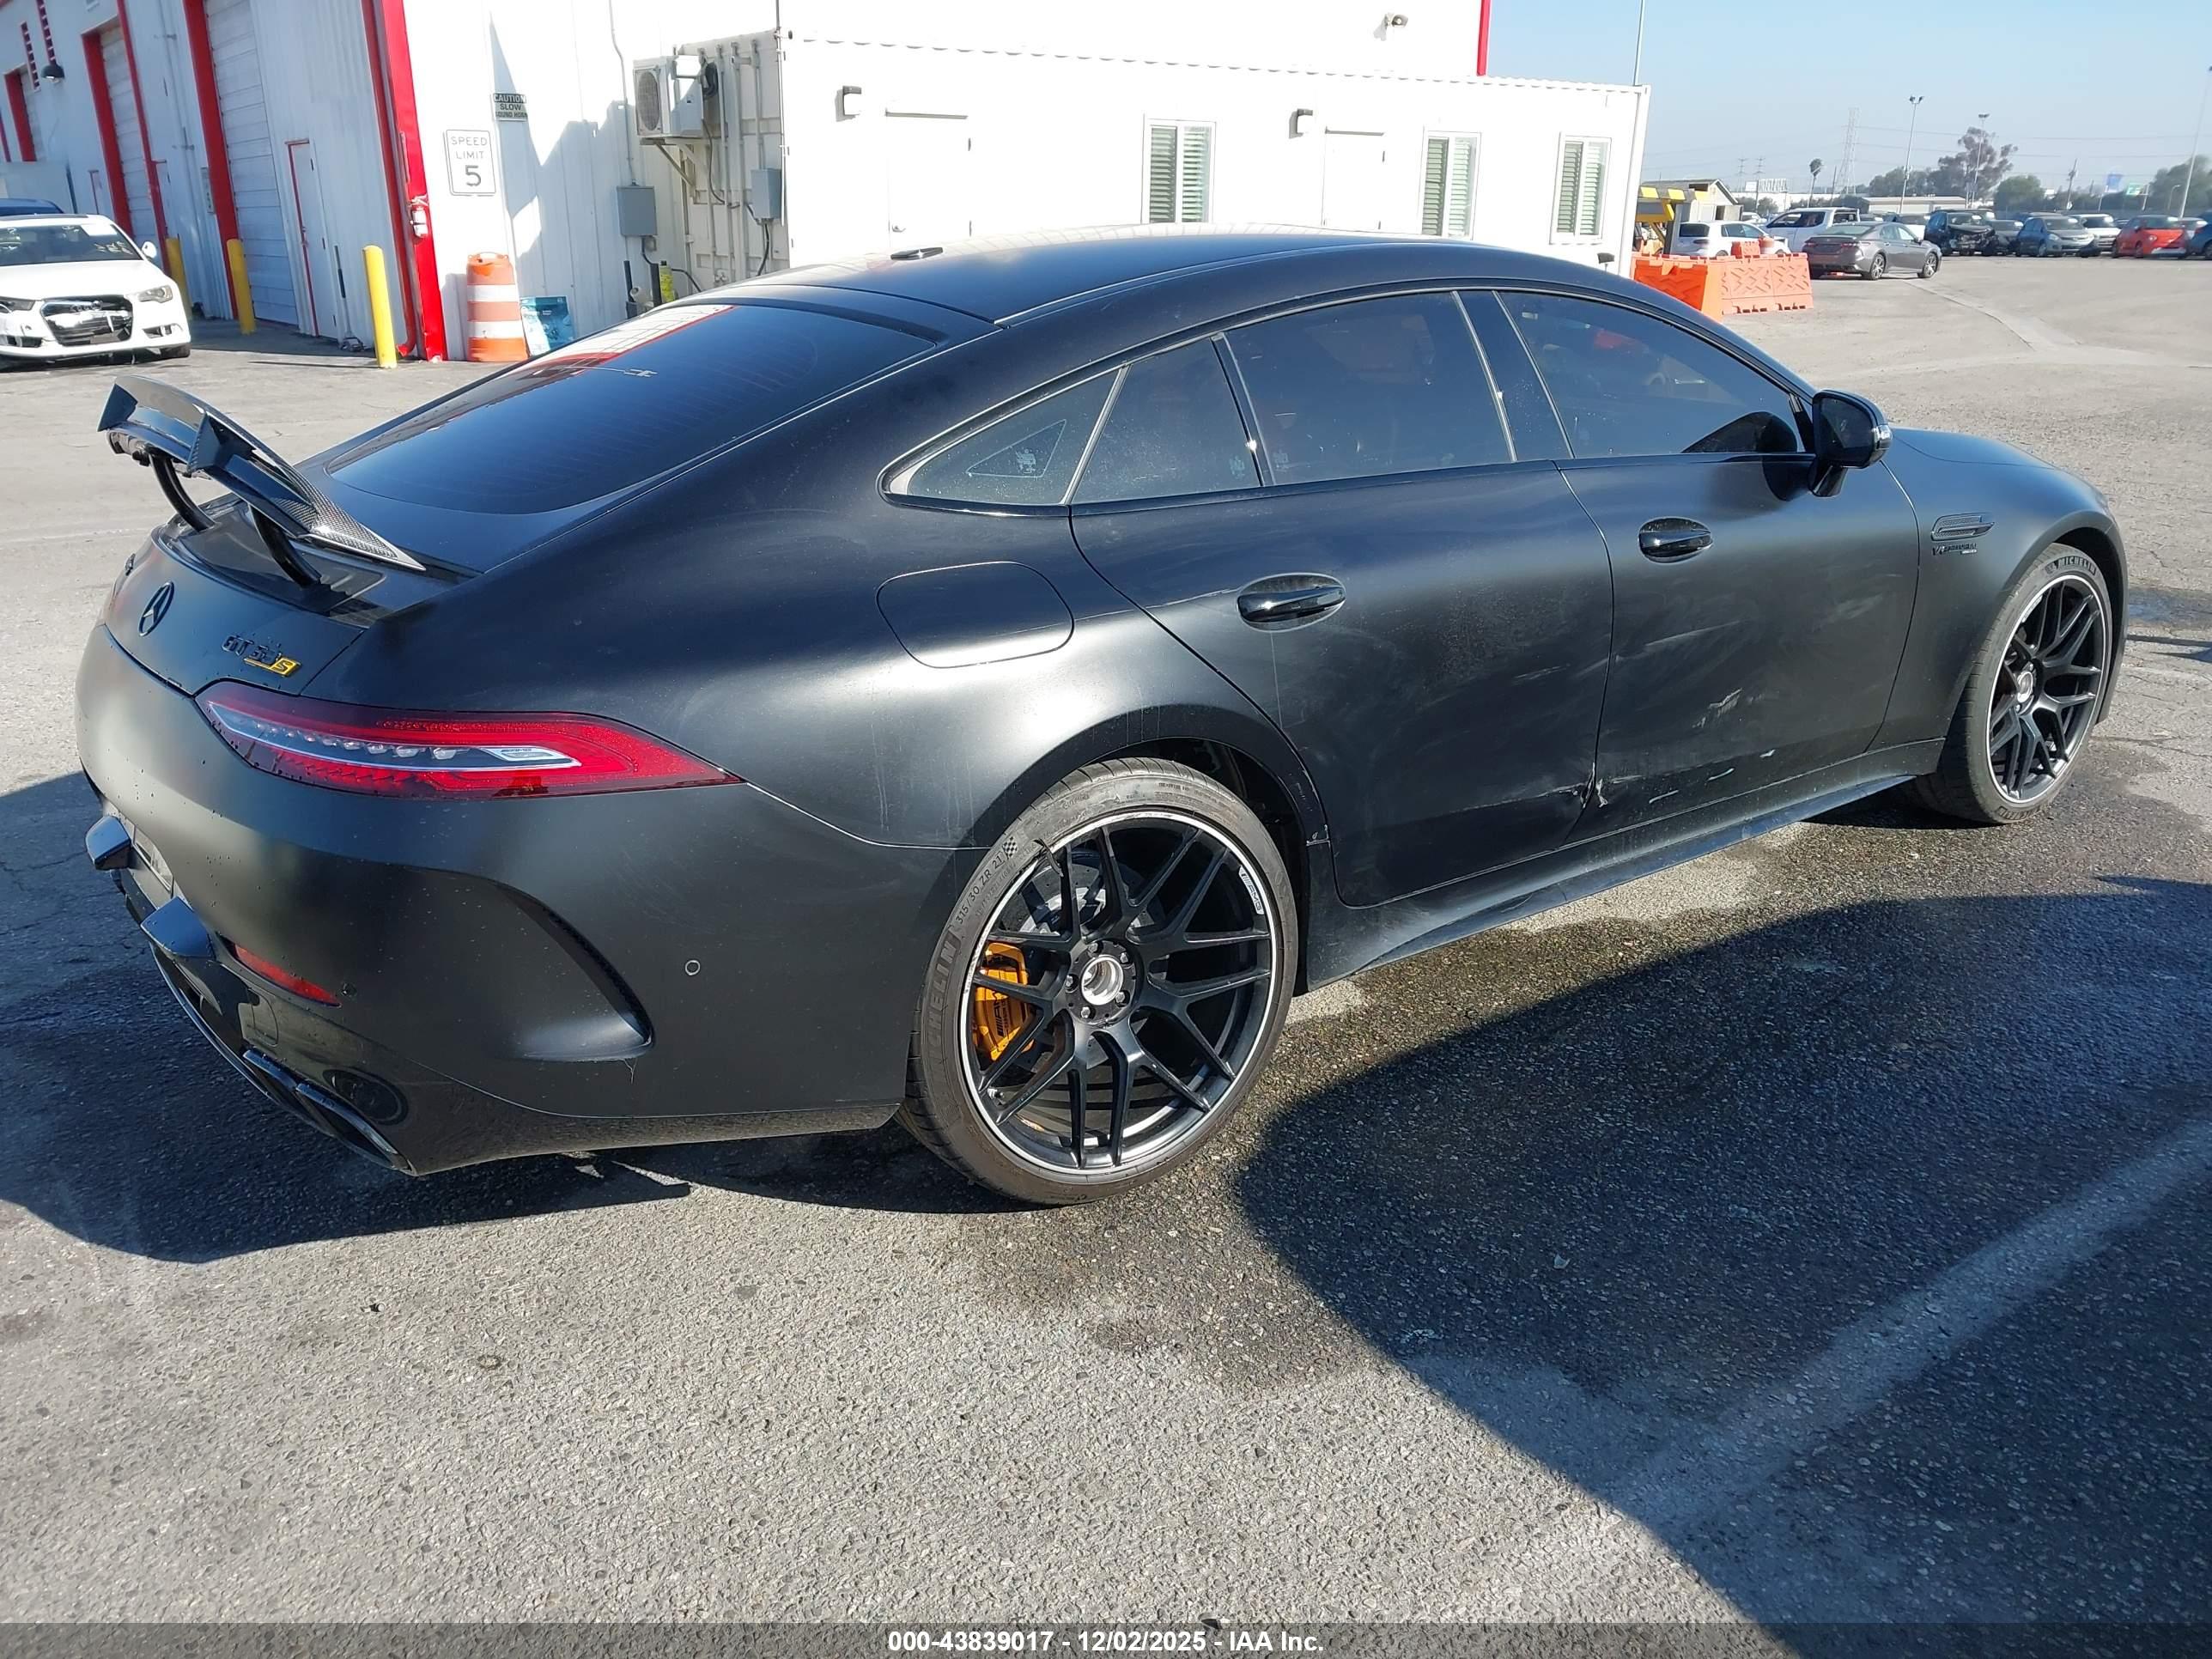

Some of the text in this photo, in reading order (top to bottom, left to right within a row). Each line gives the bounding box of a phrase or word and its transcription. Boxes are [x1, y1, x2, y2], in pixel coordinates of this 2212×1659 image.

[494, 94, 526, 103] CAUTION
[451, 136, 488, 146] SPEED
[455, 150, 484, 160] LIMIT
[465, 164, 482, 186] 5
[2057, 556, 2096, 574] MICHELIN
